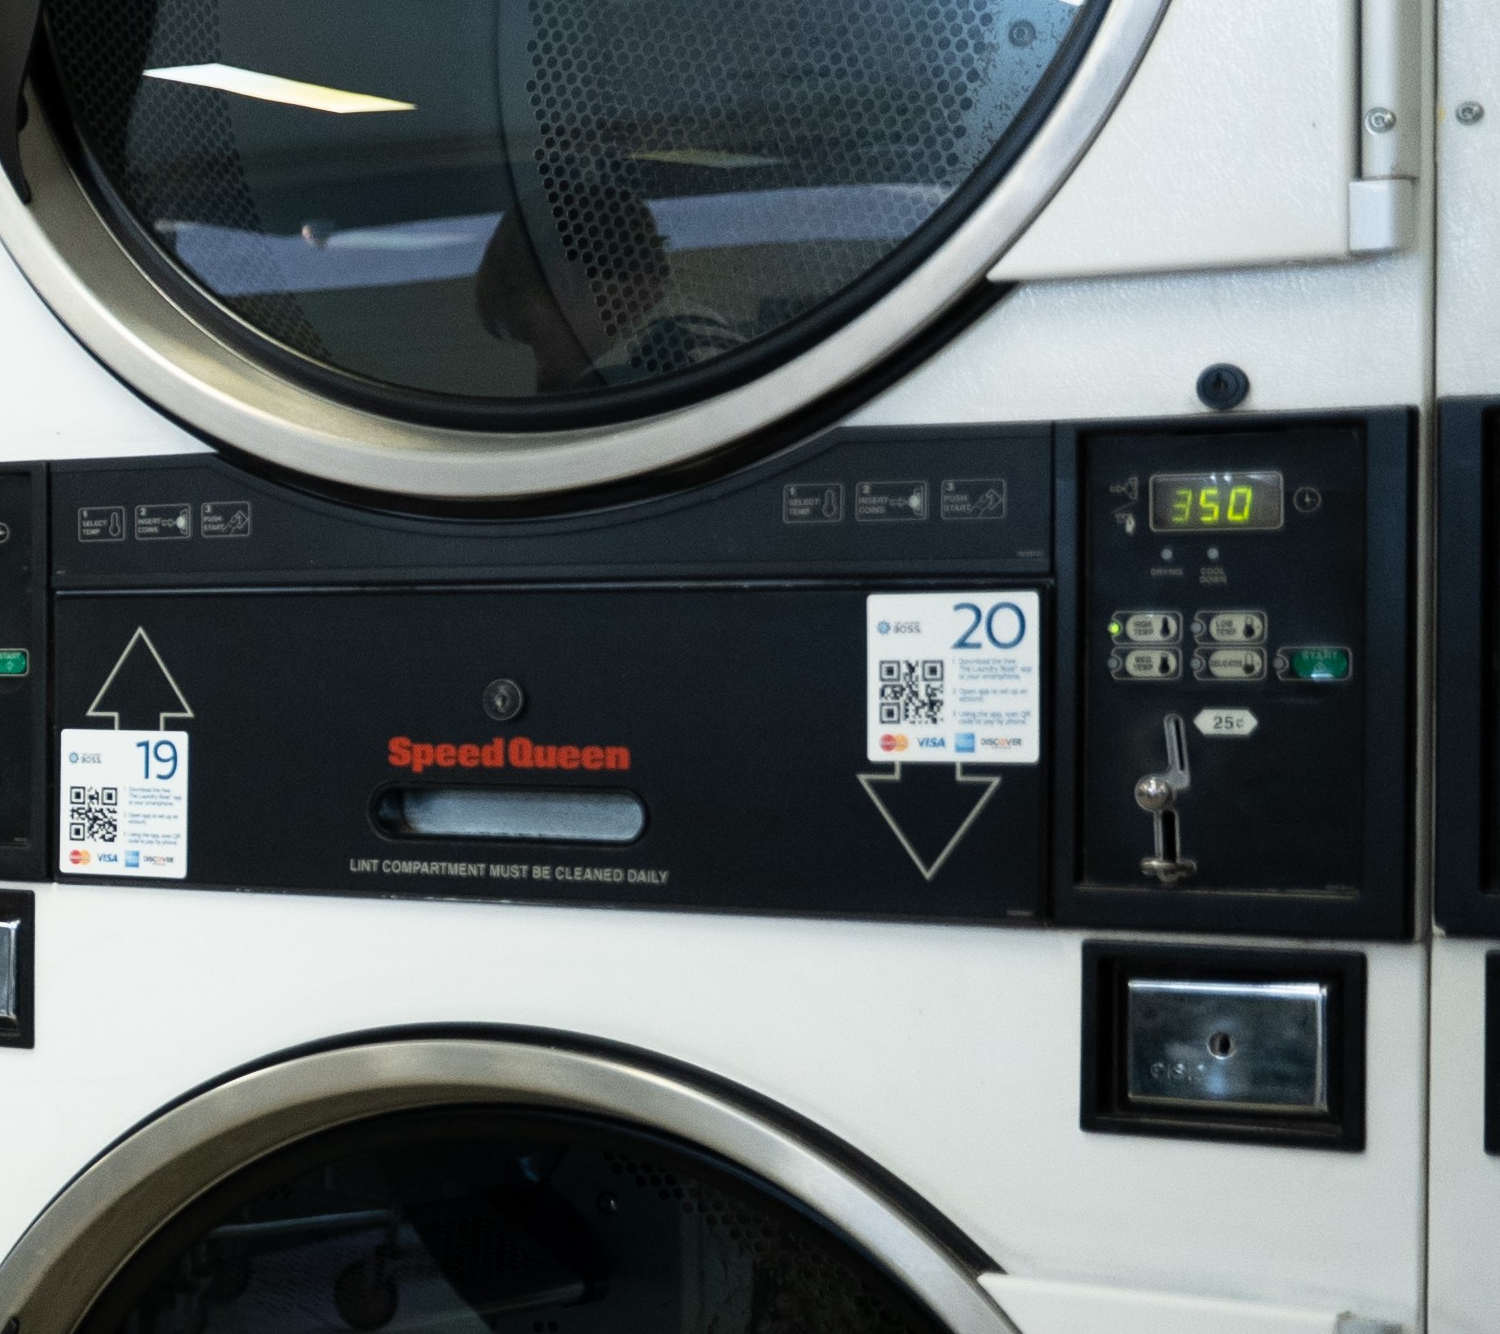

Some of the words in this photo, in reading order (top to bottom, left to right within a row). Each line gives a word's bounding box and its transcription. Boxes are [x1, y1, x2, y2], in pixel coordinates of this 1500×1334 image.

[789, 486, 796, 496] 1
[863, 484, 871, 494] 2
[946, 482, 954, 491] 3
[788, 498, 820, 506] SELECT
[858, 496, 889, 505] INSERT
[943, 494, 968, 503] PUSH
[788, 507, 812, 515] TEMP
[858, 506, 886, 514] COINS
[943, 504, 972, 512] START
[950, 601, 1026, 649] 20
[1215, 620, 1233, 628] LOW
[1215, 628, 1237, 636] TEMP
[1301, 651, 1337, 660] START
[917, 737, 946, 747] VISA
[388, 736, 505, 773] Speed
[508, 737, 631, 770] Queen
[136, 739, 178, 780] 19
[97, 854, 118, 863] VISA
[350, 858, 379, 872] LINT
[382, 860, 486, 877] COMPARTMENT
[490, 864, 529, 879] MUST
[532, 866, 551, 879] BE
[555, 867, 624, 883] CLEANED
[627, 869, 668, 884] DAILY
